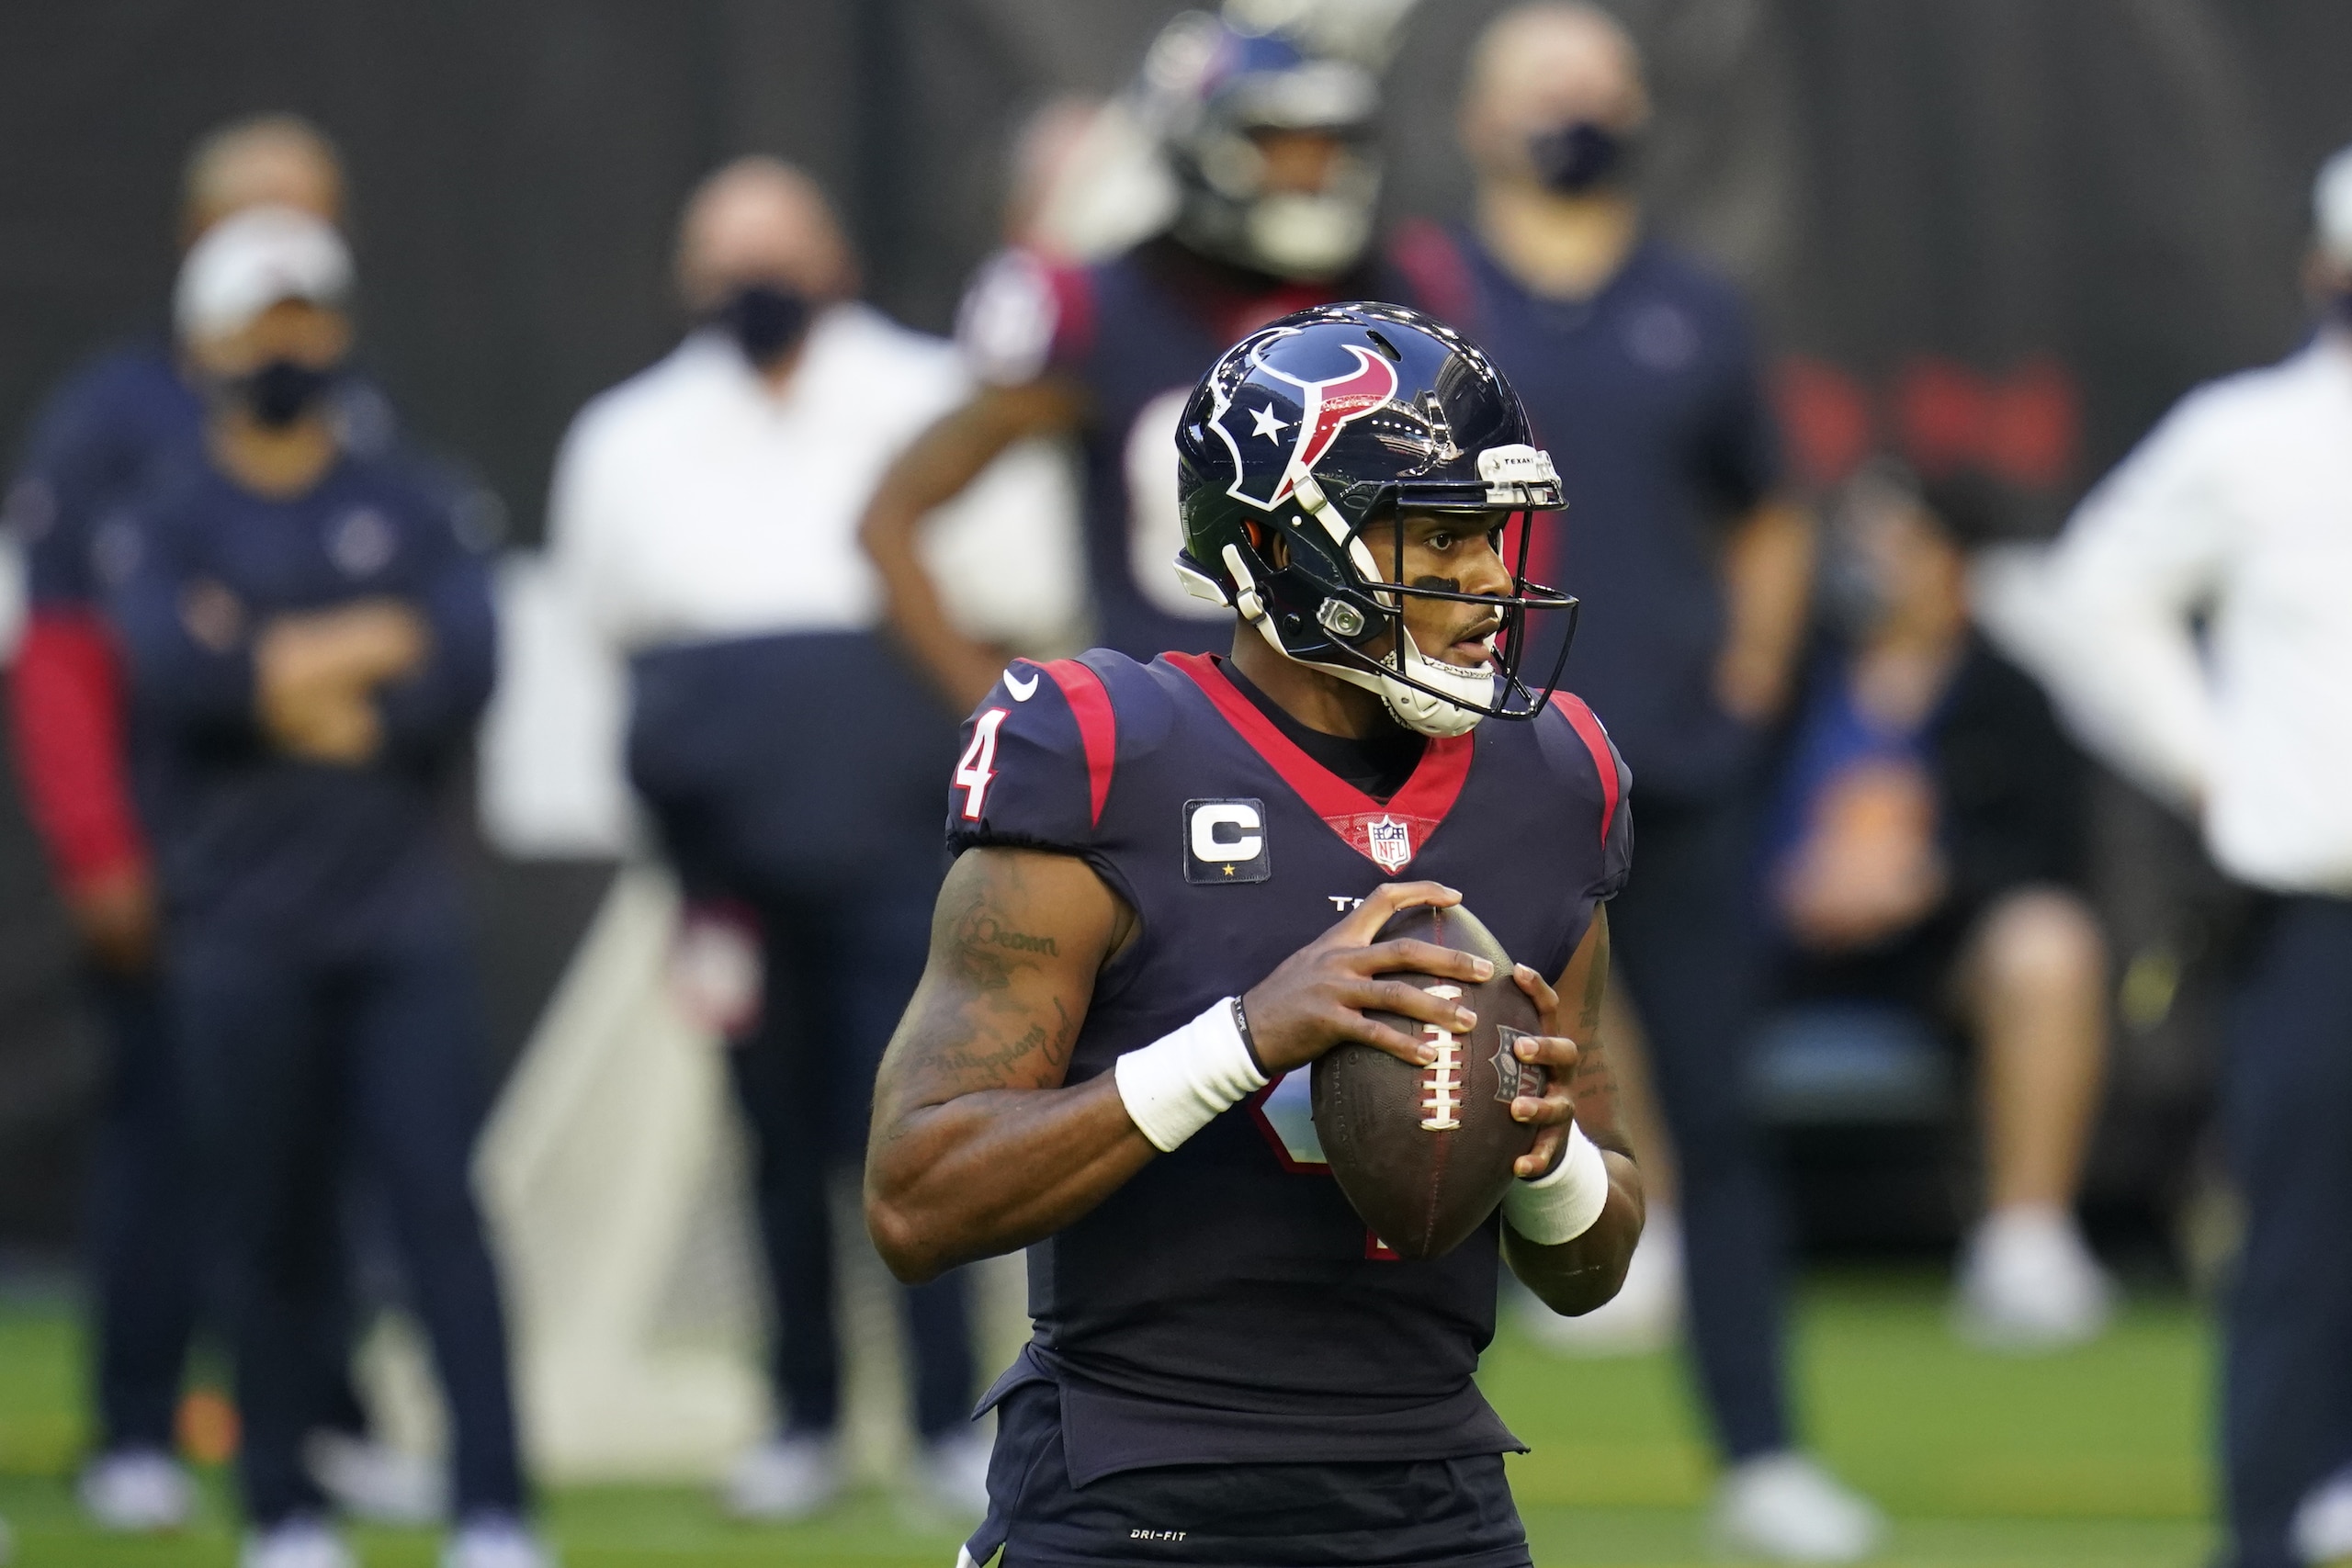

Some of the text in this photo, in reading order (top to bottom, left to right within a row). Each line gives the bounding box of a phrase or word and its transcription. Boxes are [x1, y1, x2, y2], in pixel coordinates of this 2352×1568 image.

[954, 707, 1011, 822] 4
[1191, 804, 1261, 863] C
[1378, 840, 1404, 861] NFL
[1130, 1529, 1186, 1541] DRI-FIT
